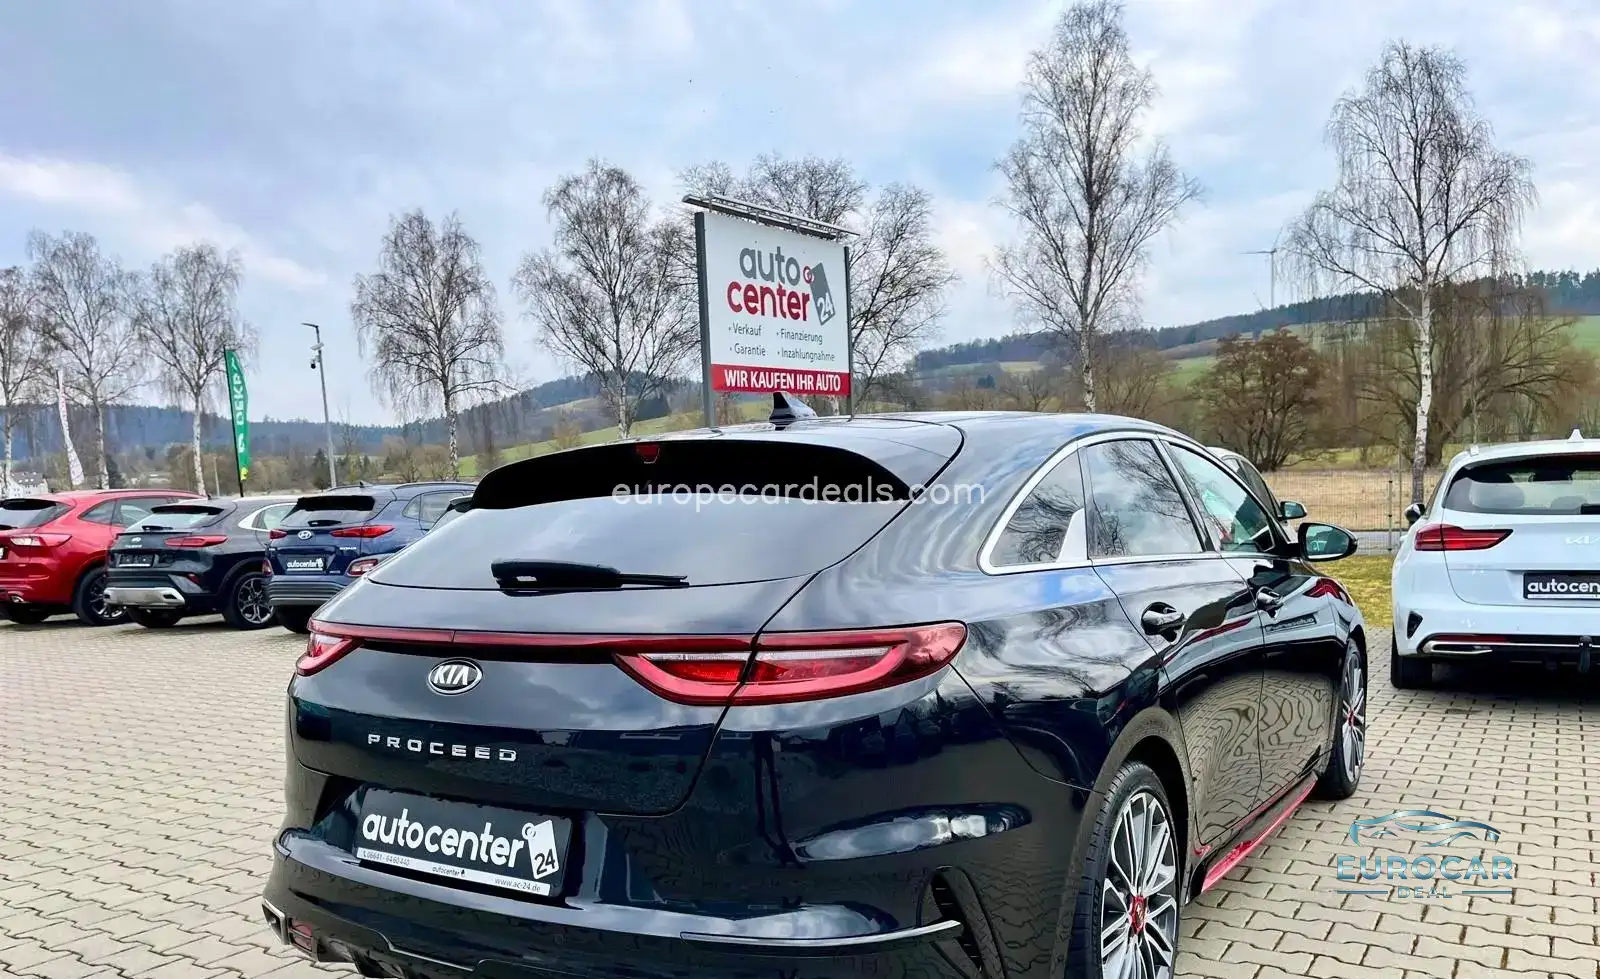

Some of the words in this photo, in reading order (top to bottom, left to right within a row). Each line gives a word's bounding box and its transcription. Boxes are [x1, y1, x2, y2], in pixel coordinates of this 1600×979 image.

[739, 246, 801, 286] auto
[727, 281, 810, 322] center
[816, 292, 833, 320] 24
[732, 322, 762, 337] Verkauf
[780, 328, 823, 344] Finanzierung
[734, 343, 766, 357] Garantie
[781, 347, 835, 363] Inzahlungnahme
[724, 369, 748, 388] WIR
[750, 371, 794, 390] KAUFEN
[796, 374, 814, 390] IHR
[816, 374, 841, 391] AUTO
[432, 664, 470, 686] KIA
[367, 733, 517, 762] PROCEED
[362, 808, 525, 868] autocenter
[431, 866, 460, 878] autocenter
[534, 847, 556, 876] 24
[494, 877, 541, 893] www.ac-24.de
